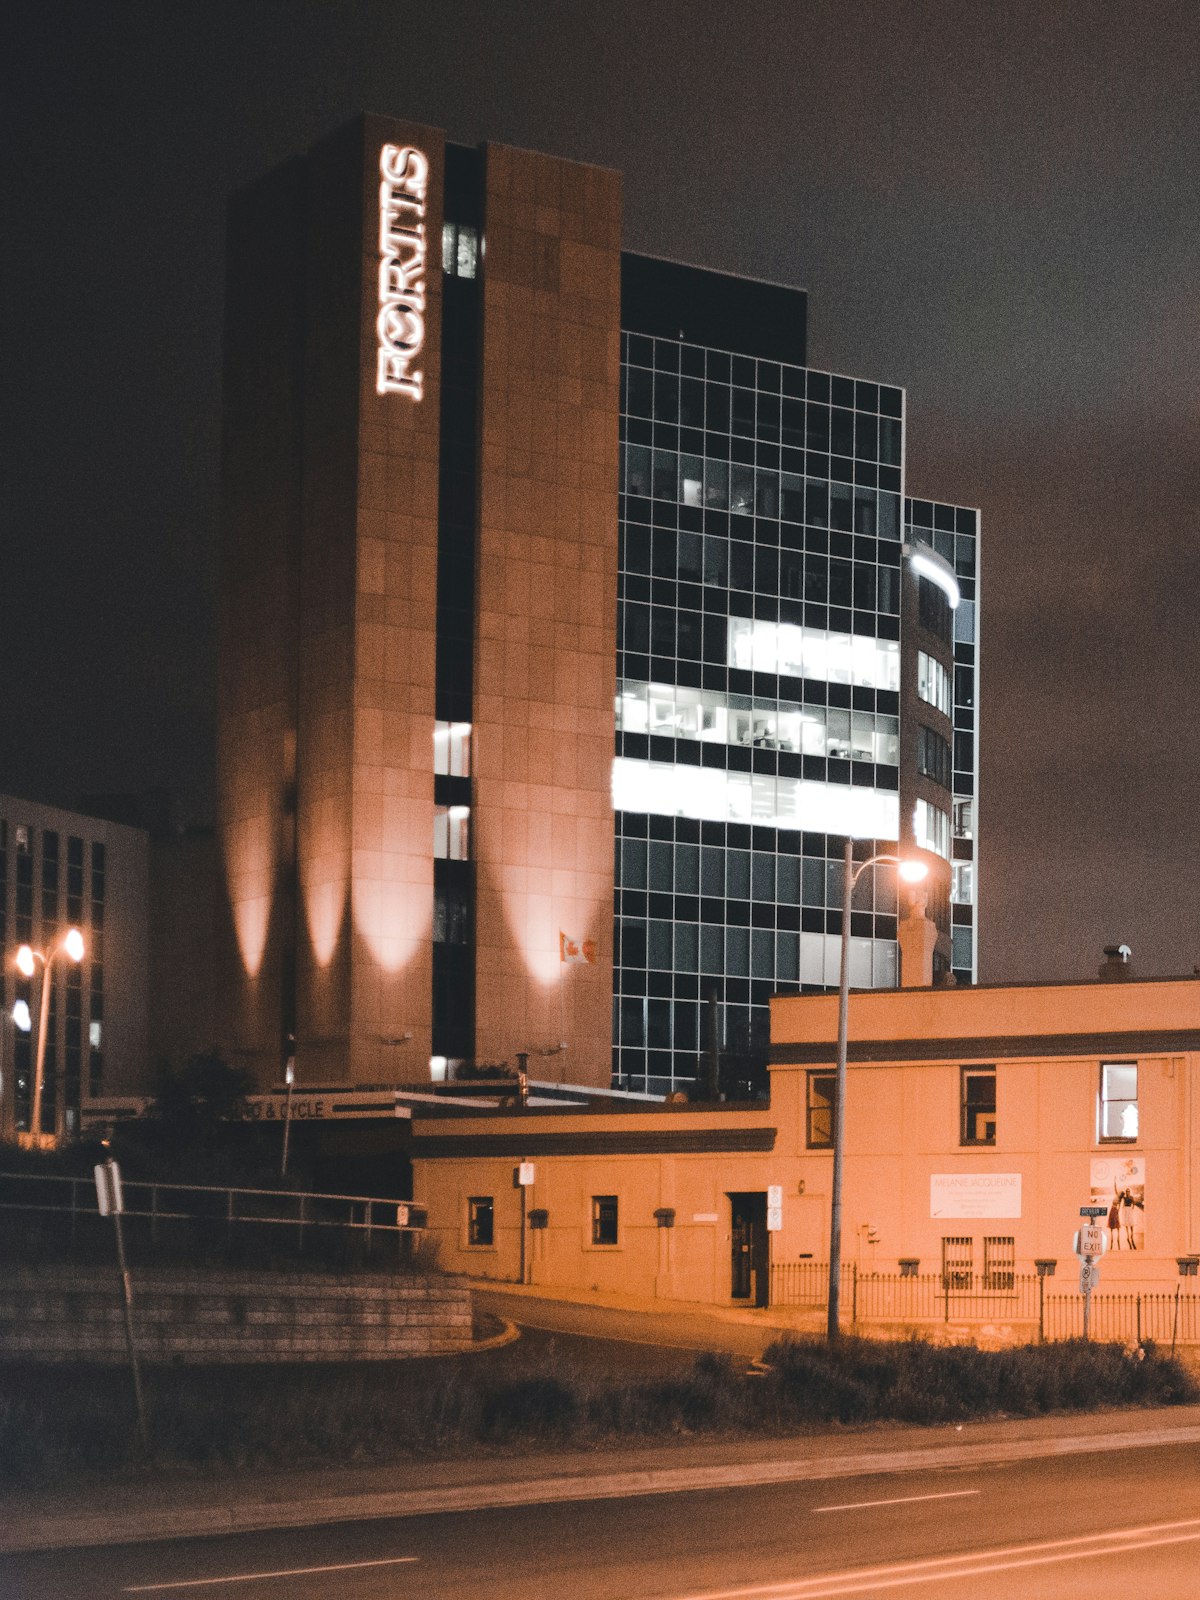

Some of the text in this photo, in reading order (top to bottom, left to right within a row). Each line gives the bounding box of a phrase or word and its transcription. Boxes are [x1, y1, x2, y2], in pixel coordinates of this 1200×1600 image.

[376, 142, 429, 402] FORTIS
[266, 1102, 275, 1118] &
[280, 1101, 324, 1118] CYCLE
[1087, 1230, 1099, 1239] NO
[1084, 1242, 1101, 1252] EXIT
